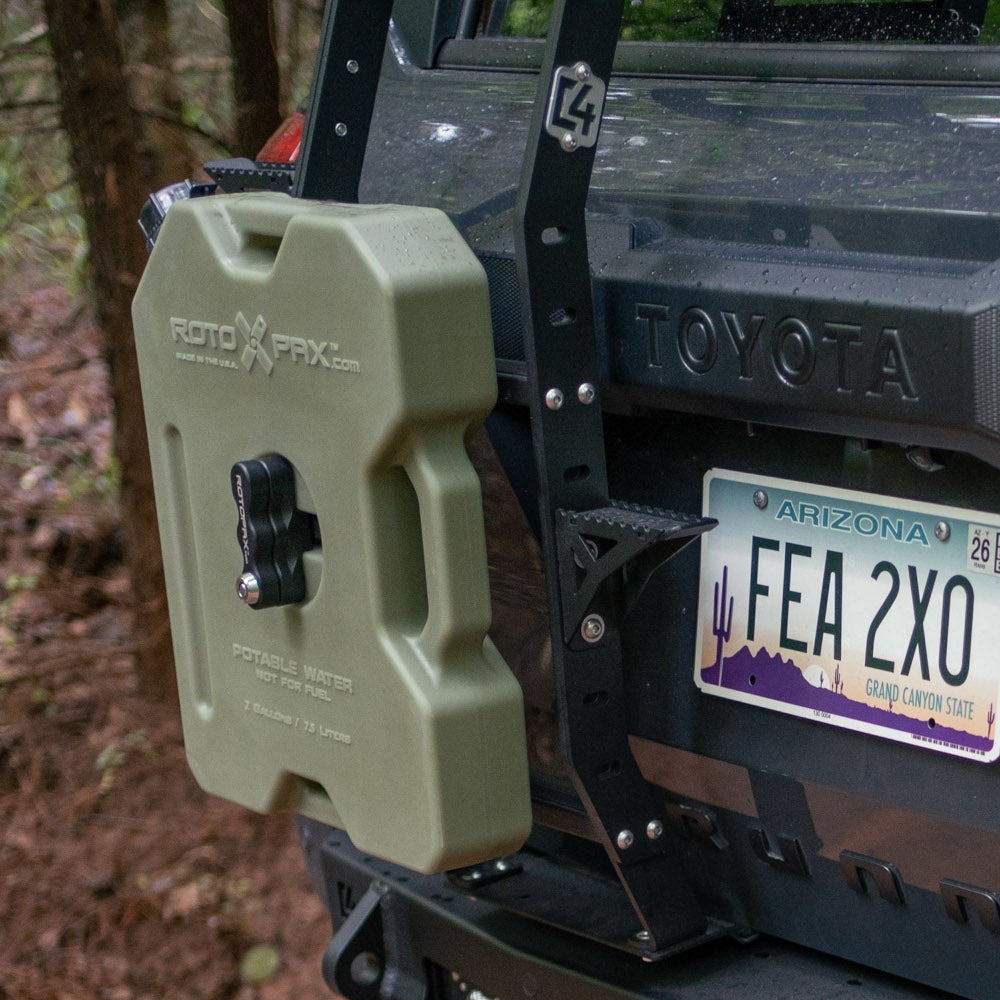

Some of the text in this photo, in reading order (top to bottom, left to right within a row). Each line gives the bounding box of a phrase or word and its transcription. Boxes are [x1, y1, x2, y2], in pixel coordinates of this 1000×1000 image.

[635, 303, 920, 401] TOYOTA
[775, 499, 930, 548] ARIZONA
[971, 536, 990, 563] 26
[747, 535, 844, 661] FEA
[232, 643, 353, 694] POTABLE WATER
[255, 668, 332, 702] NOT FOR FUEL
[866, 678, 975, 720] GRAND CANYON STATE
